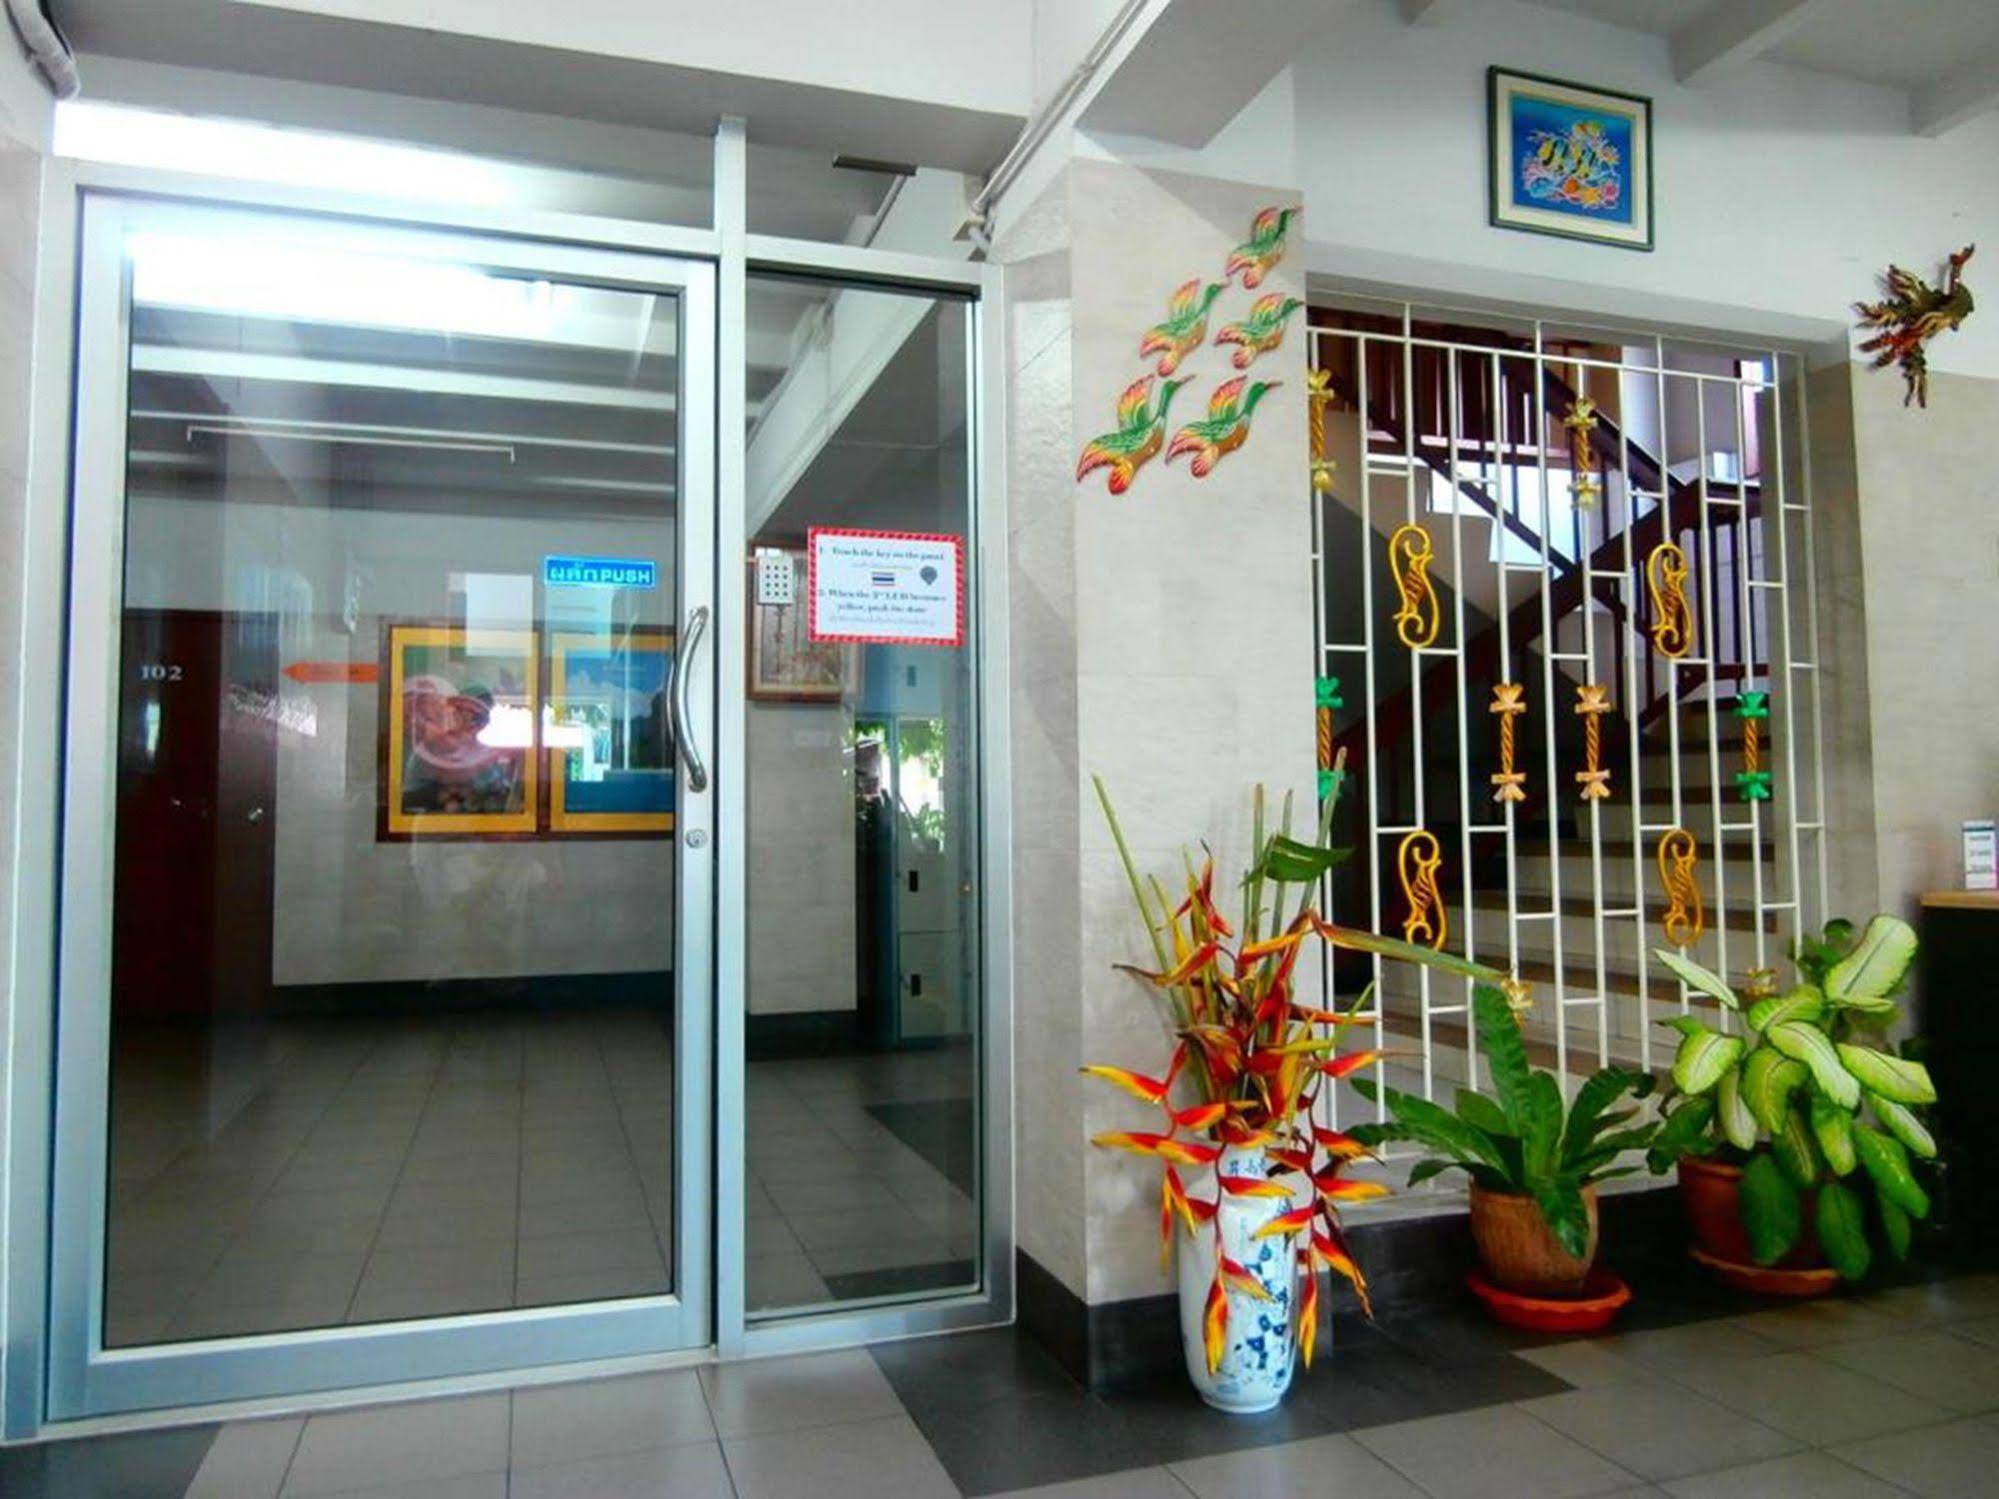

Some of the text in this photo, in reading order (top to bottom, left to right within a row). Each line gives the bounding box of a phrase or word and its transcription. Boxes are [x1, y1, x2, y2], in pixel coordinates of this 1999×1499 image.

[860, 548, 874, 557] the
[876, 548, 891, 559] key
[905, 550, 919, 559] the
[920, 552, 944, 561] panel
[549, 561, 598, 581] ผลัก
[600, 568, 650, 584] PUSH
[828, 588, 855, 598] When
[856, 589, 870, 599] the
[140, 664, 183, 681] 102
